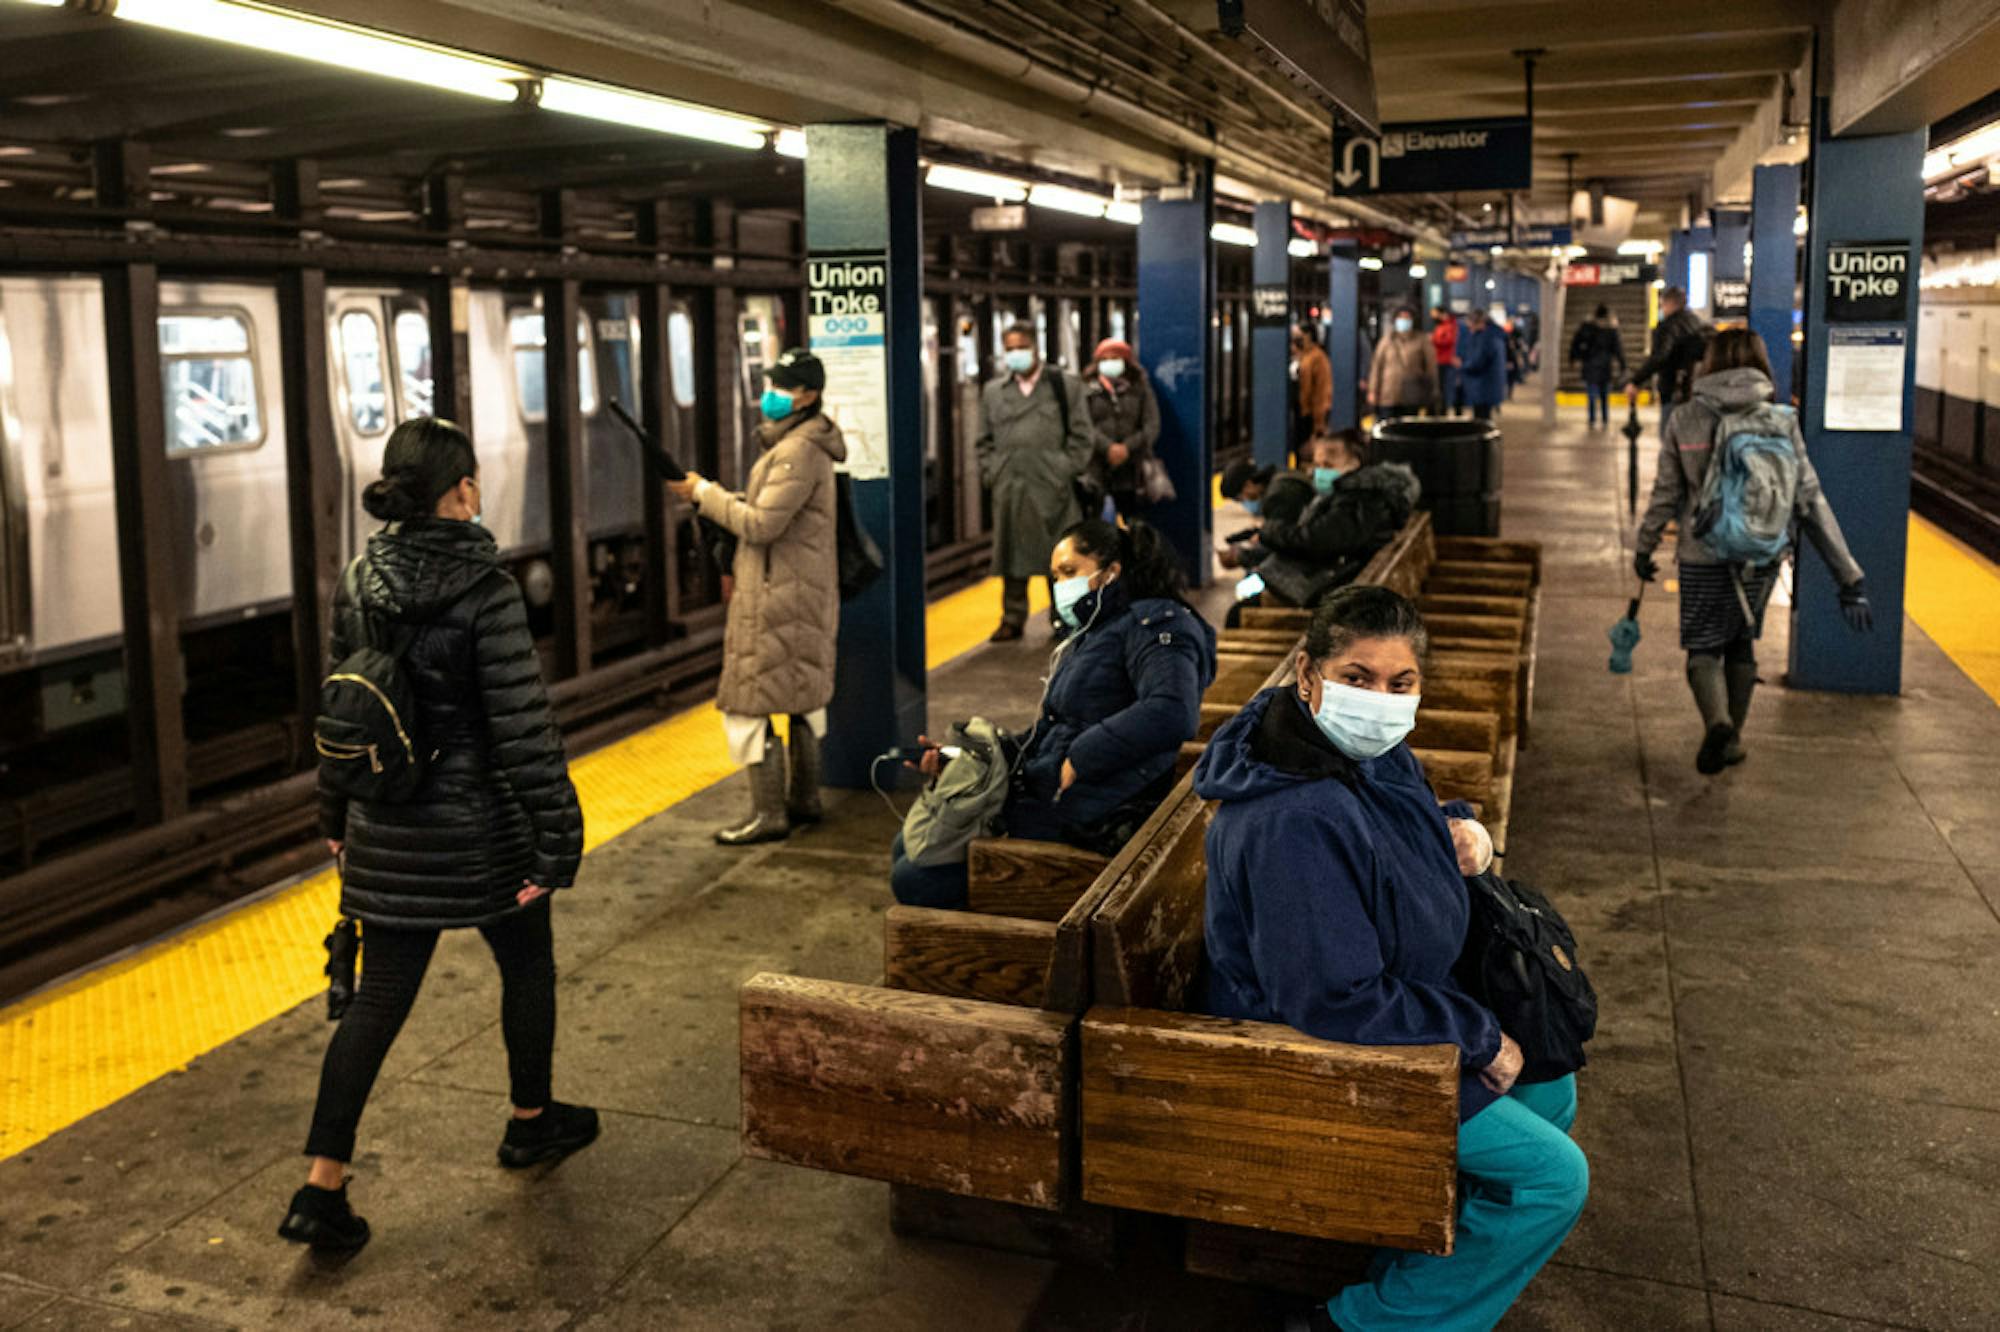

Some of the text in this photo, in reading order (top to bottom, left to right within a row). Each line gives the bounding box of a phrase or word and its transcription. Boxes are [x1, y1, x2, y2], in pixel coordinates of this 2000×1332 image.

[1406, 130, 1488, 151] Elevator
[1828, 249, 1905, 274] Union
[809, 262, 884, 289] Union
[1828, 274, 1899, 301] T'pke
